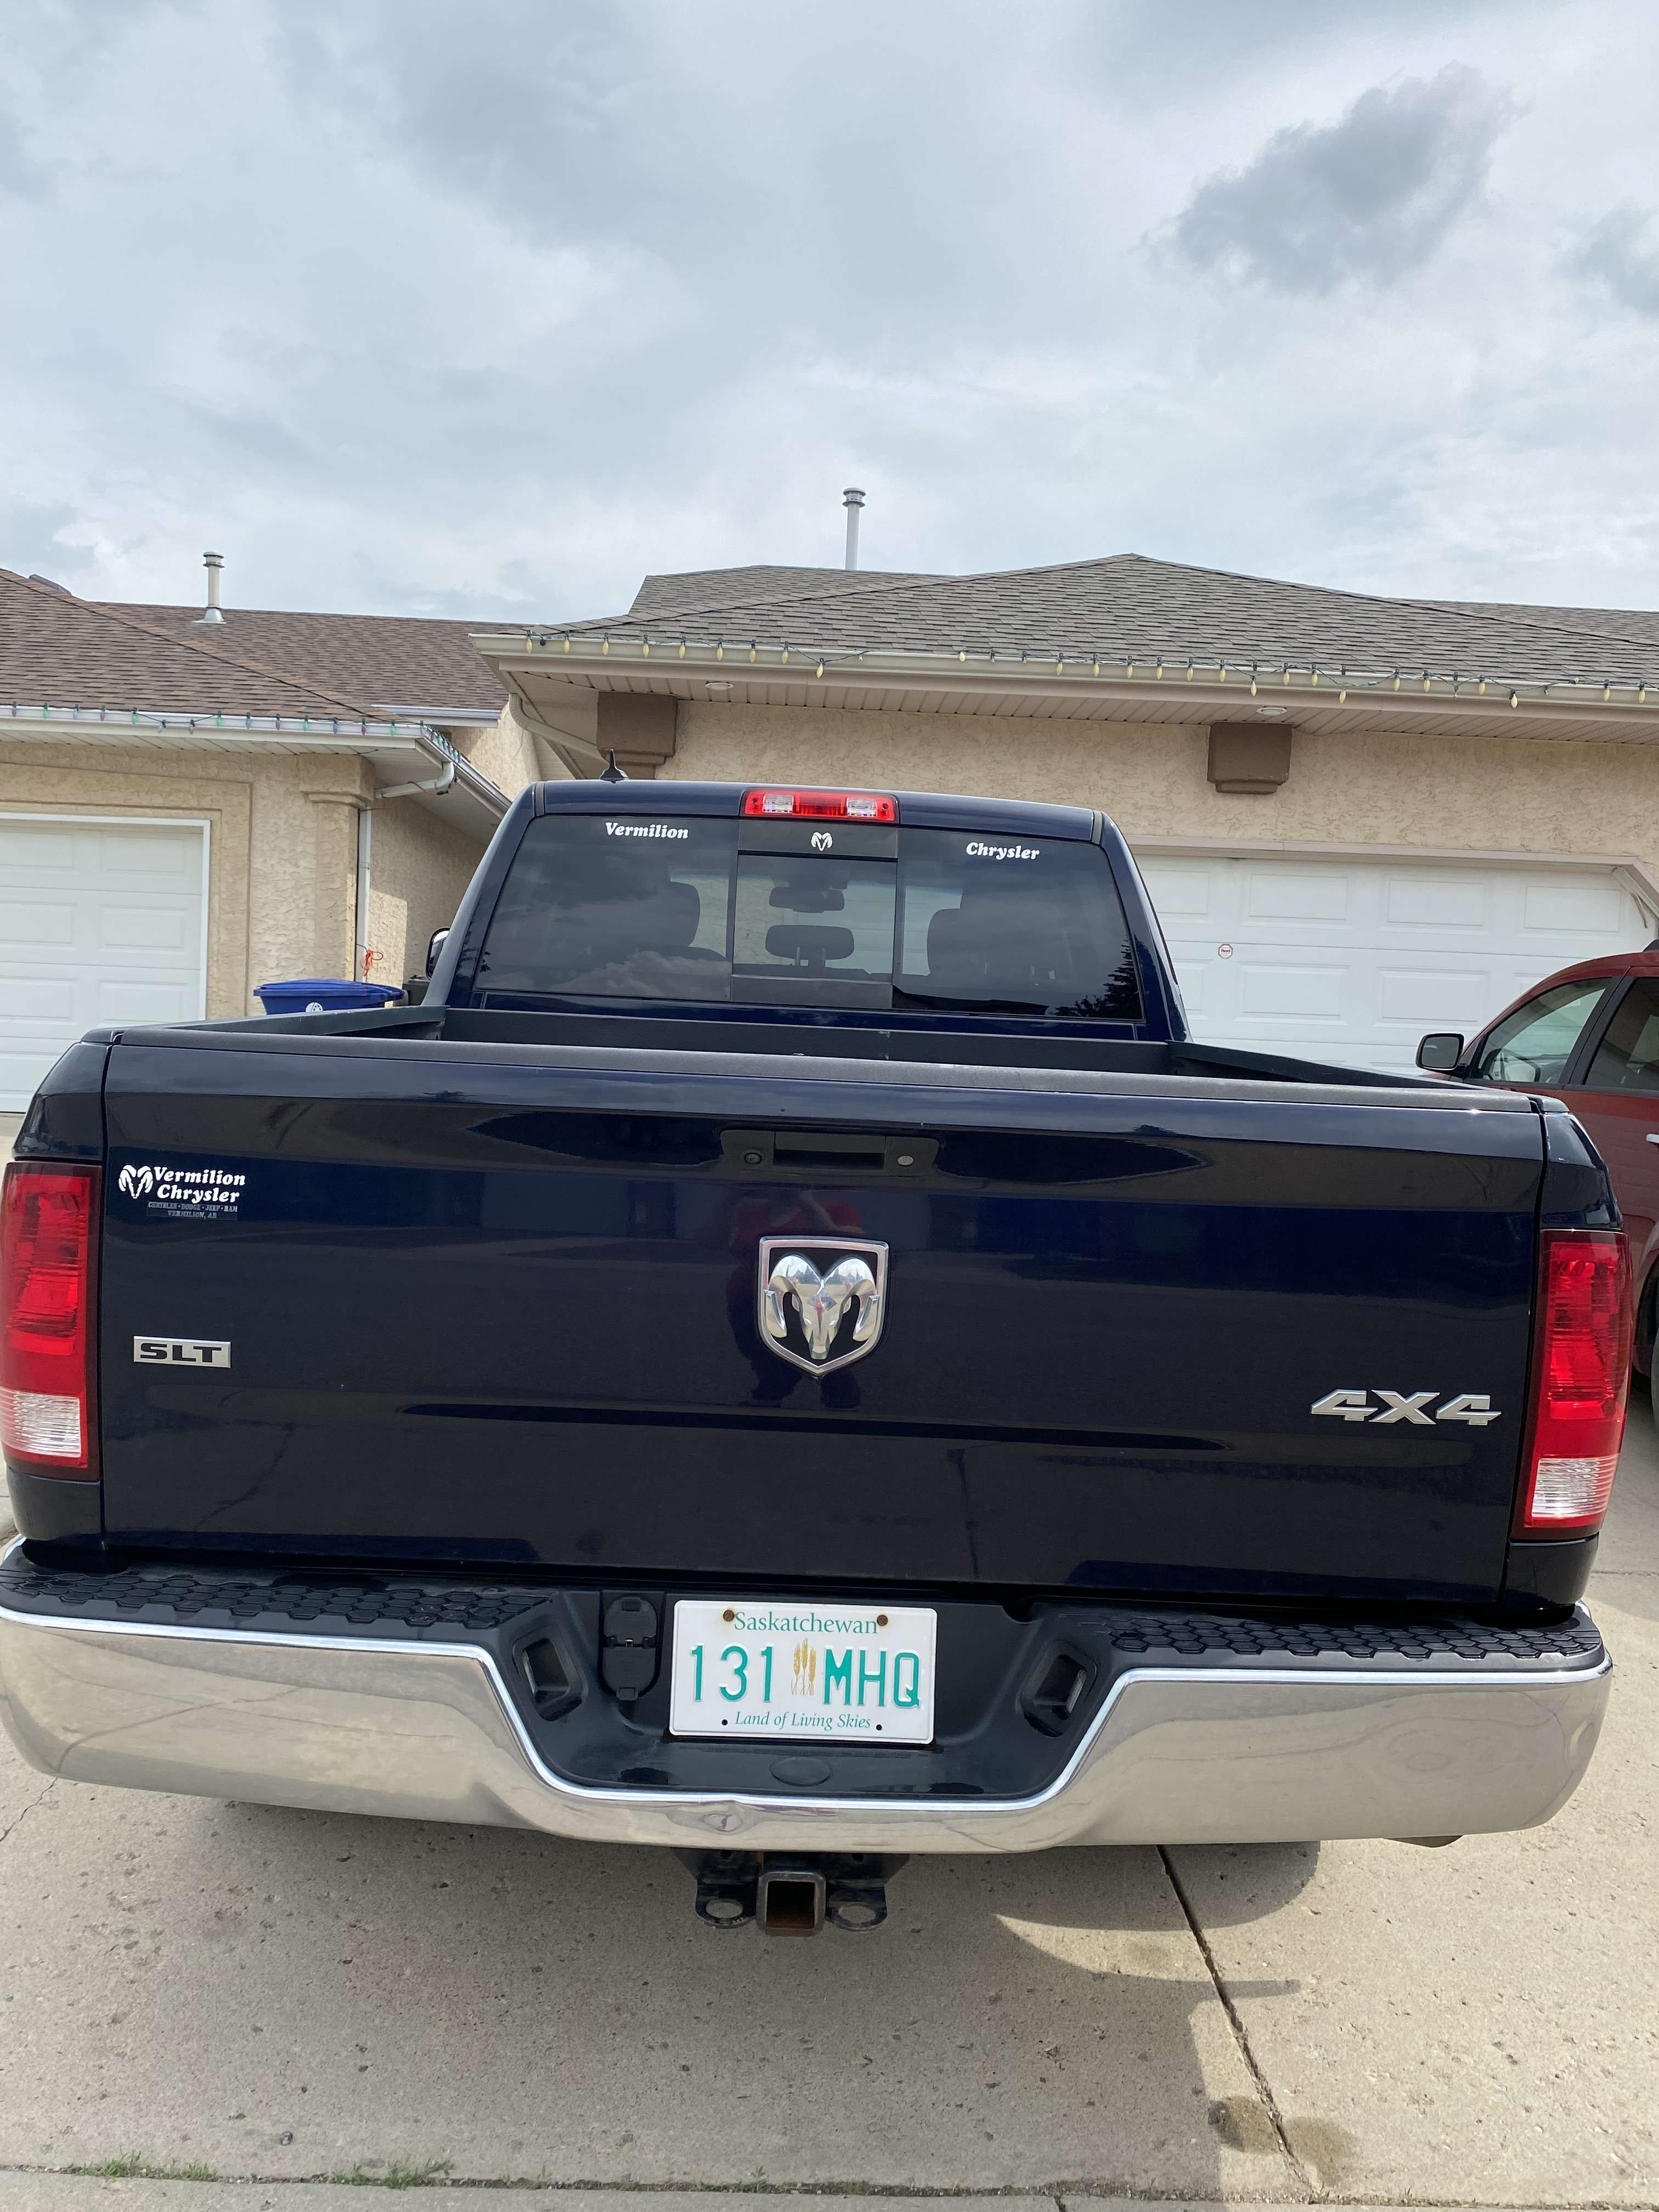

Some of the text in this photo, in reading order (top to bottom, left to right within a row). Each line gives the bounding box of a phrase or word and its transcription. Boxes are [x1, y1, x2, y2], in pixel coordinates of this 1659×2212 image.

[605, 822, 689, 839] Vermilion
[966, 842, 1040, 860] Chrysler
[154, 1166, 246, 1186] Vermilion
[157, 1184, 240, 1204] Chrysler
[140, 1342, 222, 1363] SLT
[1310, 1389, 1502, 1426] 4X4
[734, 1611, 878, 1634] Saskatchewan
[690, 1644, 921, 1708] 131 MHQ
[735, 1711, 871, 1731] Land of Living Skies
